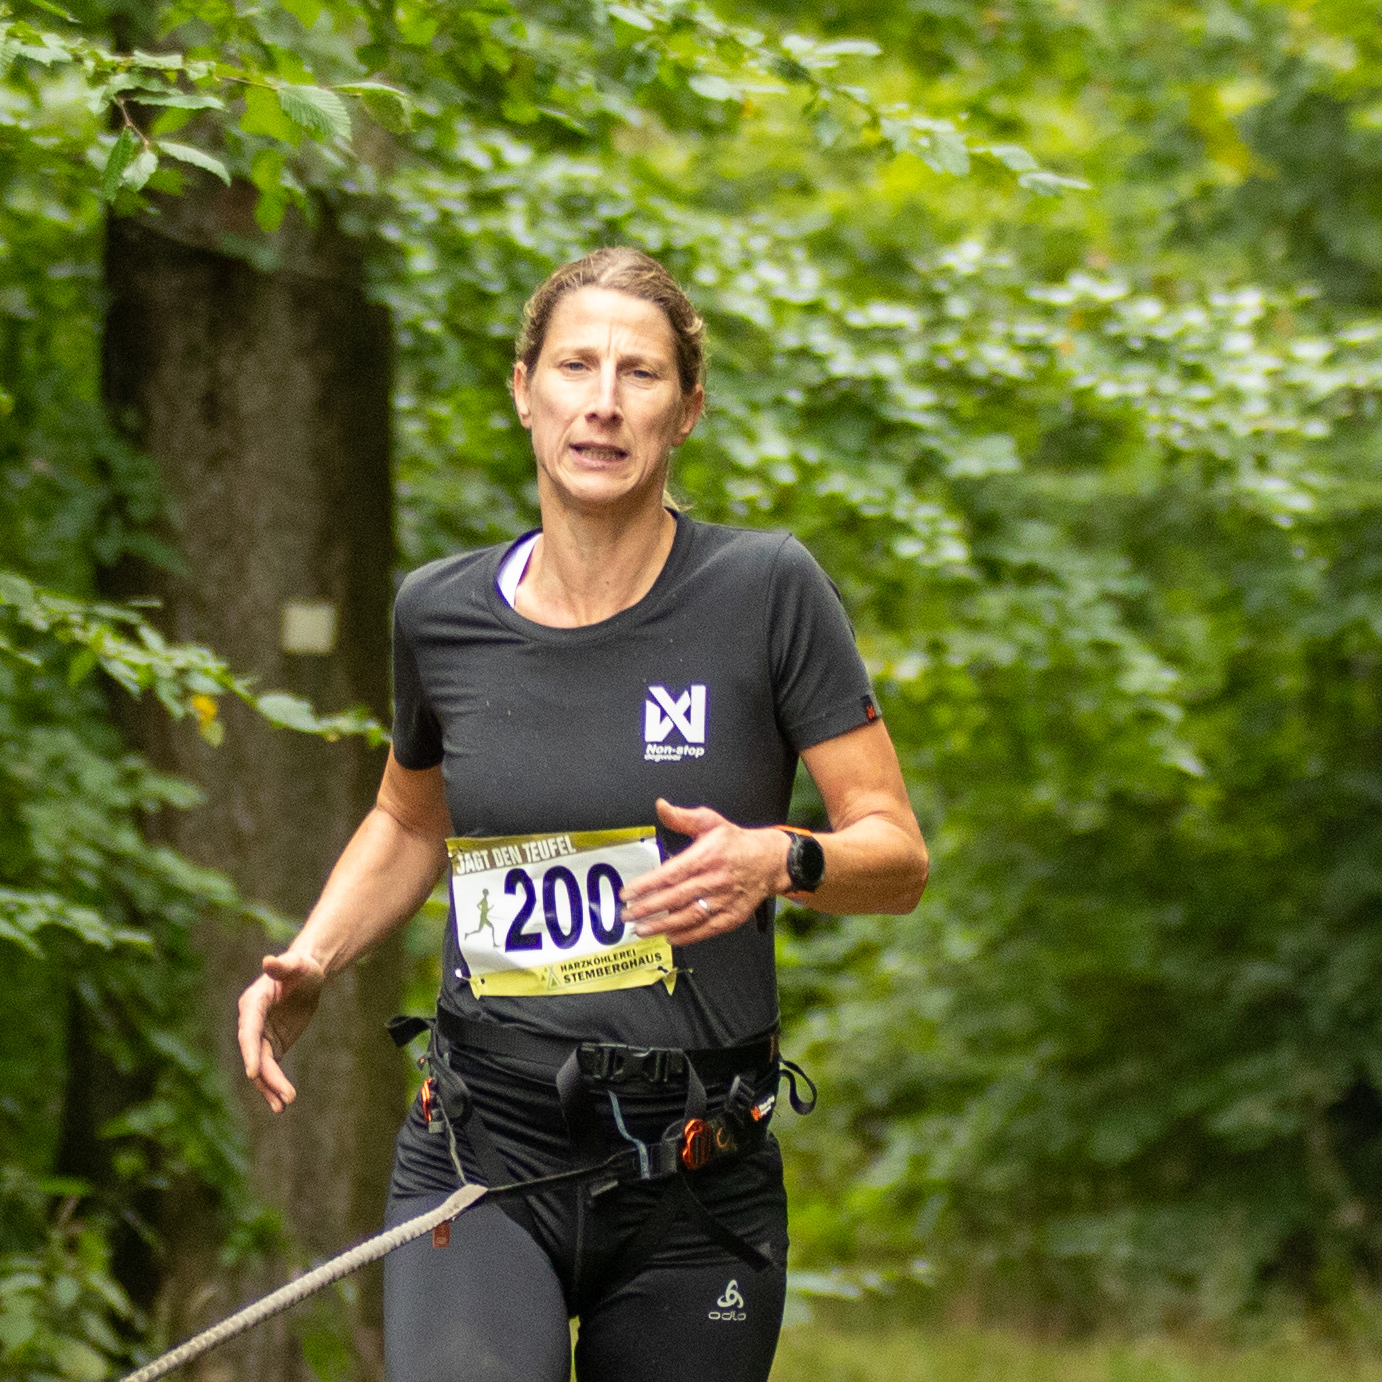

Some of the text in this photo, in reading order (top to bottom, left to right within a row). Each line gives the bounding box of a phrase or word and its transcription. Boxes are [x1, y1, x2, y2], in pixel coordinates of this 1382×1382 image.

[456, 835, 576, 875] JAGT DEN TEUFEL
[504, 862, 627, 952] 200
[560, 949, 636, 972] HARZKÖHLEREI
[563, 952, 662, 983] STEMBERGHAUS
[708, 1310, 747, 1321] odlo
